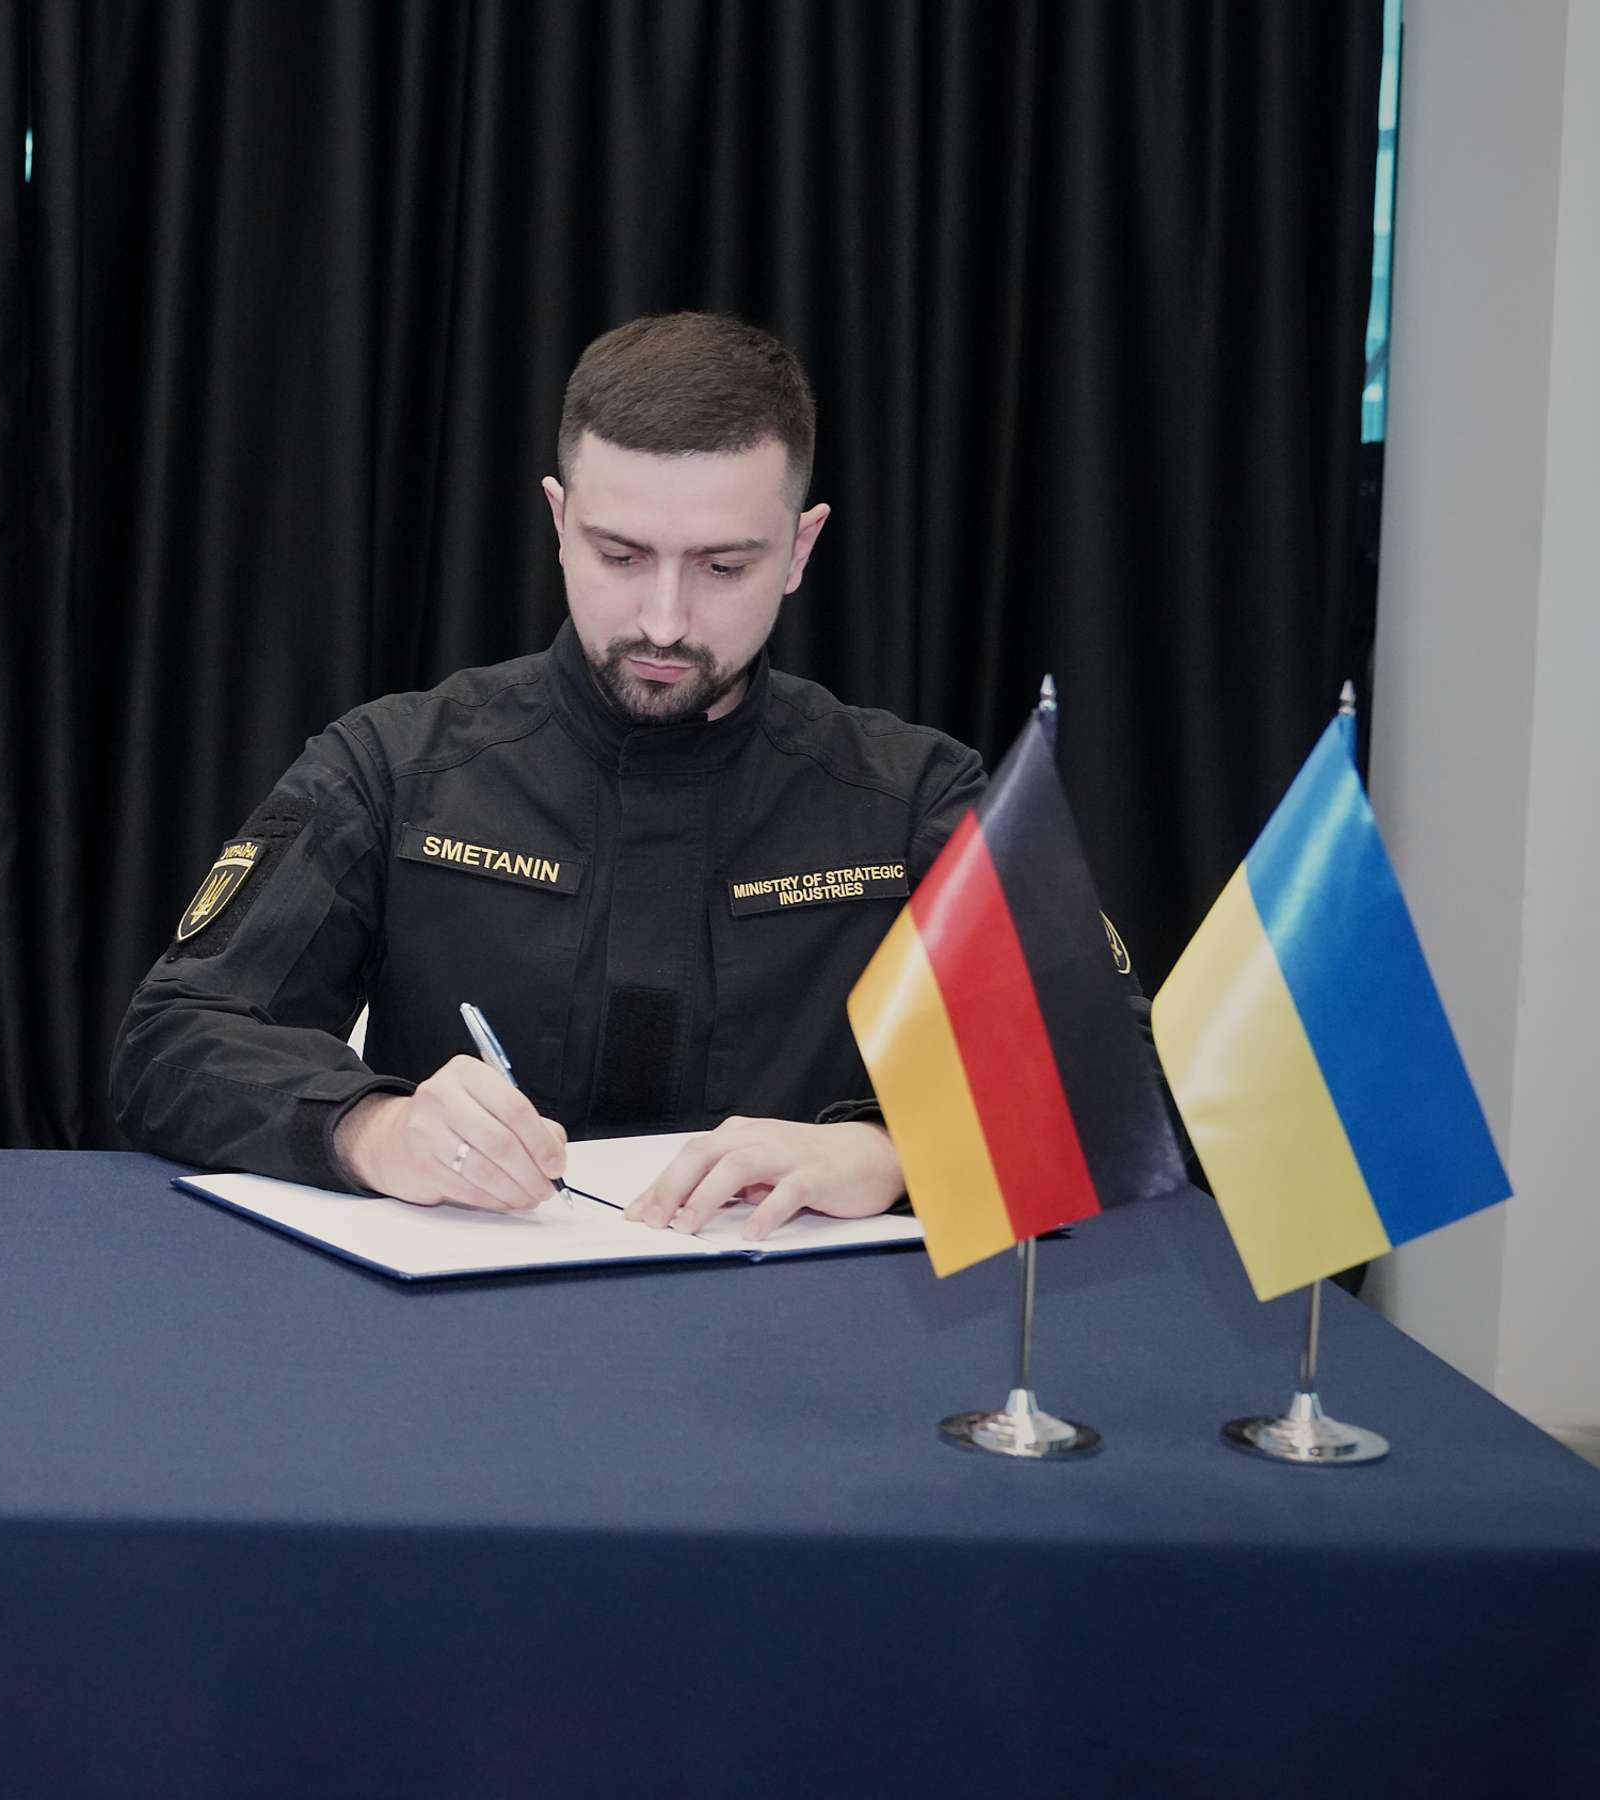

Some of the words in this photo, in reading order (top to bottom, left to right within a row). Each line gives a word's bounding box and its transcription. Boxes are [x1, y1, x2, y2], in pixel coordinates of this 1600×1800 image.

[422, 836, 560, 883] SMETANIN
[733, 876, 799, 898] MINISTRY
[803, 873, 822, 887] OF
[826, 865, 904, 884] STRATEGIC
[778, 883, 864, 905] INDUSTRIES
